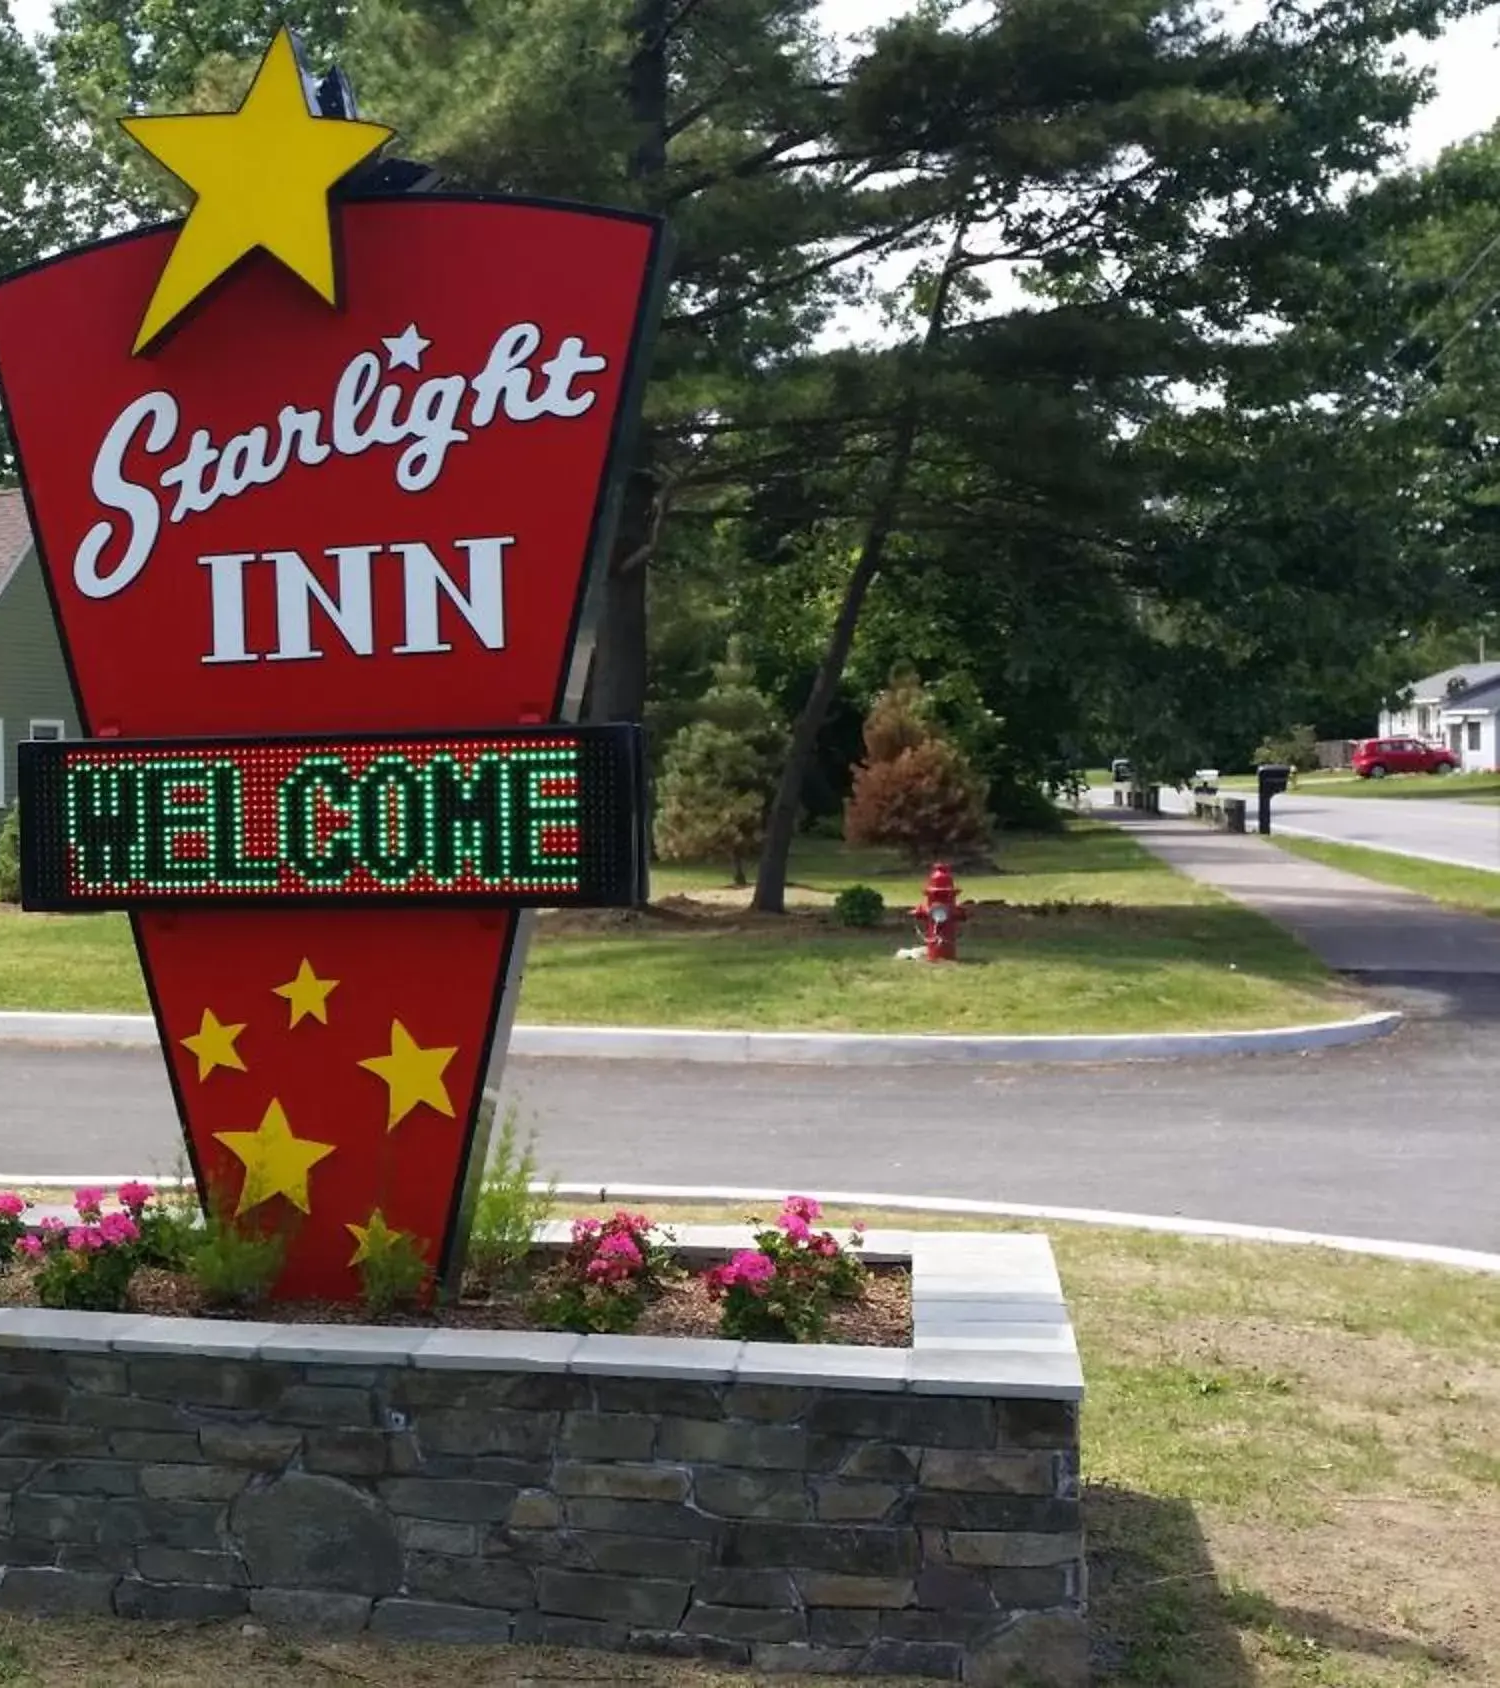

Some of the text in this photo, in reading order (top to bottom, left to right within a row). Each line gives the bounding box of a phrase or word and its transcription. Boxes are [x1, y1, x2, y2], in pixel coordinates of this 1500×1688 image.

[72, 322, 606, 600] Starlight
[198, 536, 516, 664] INN
[67, 749, 579, 888] WELCOME
